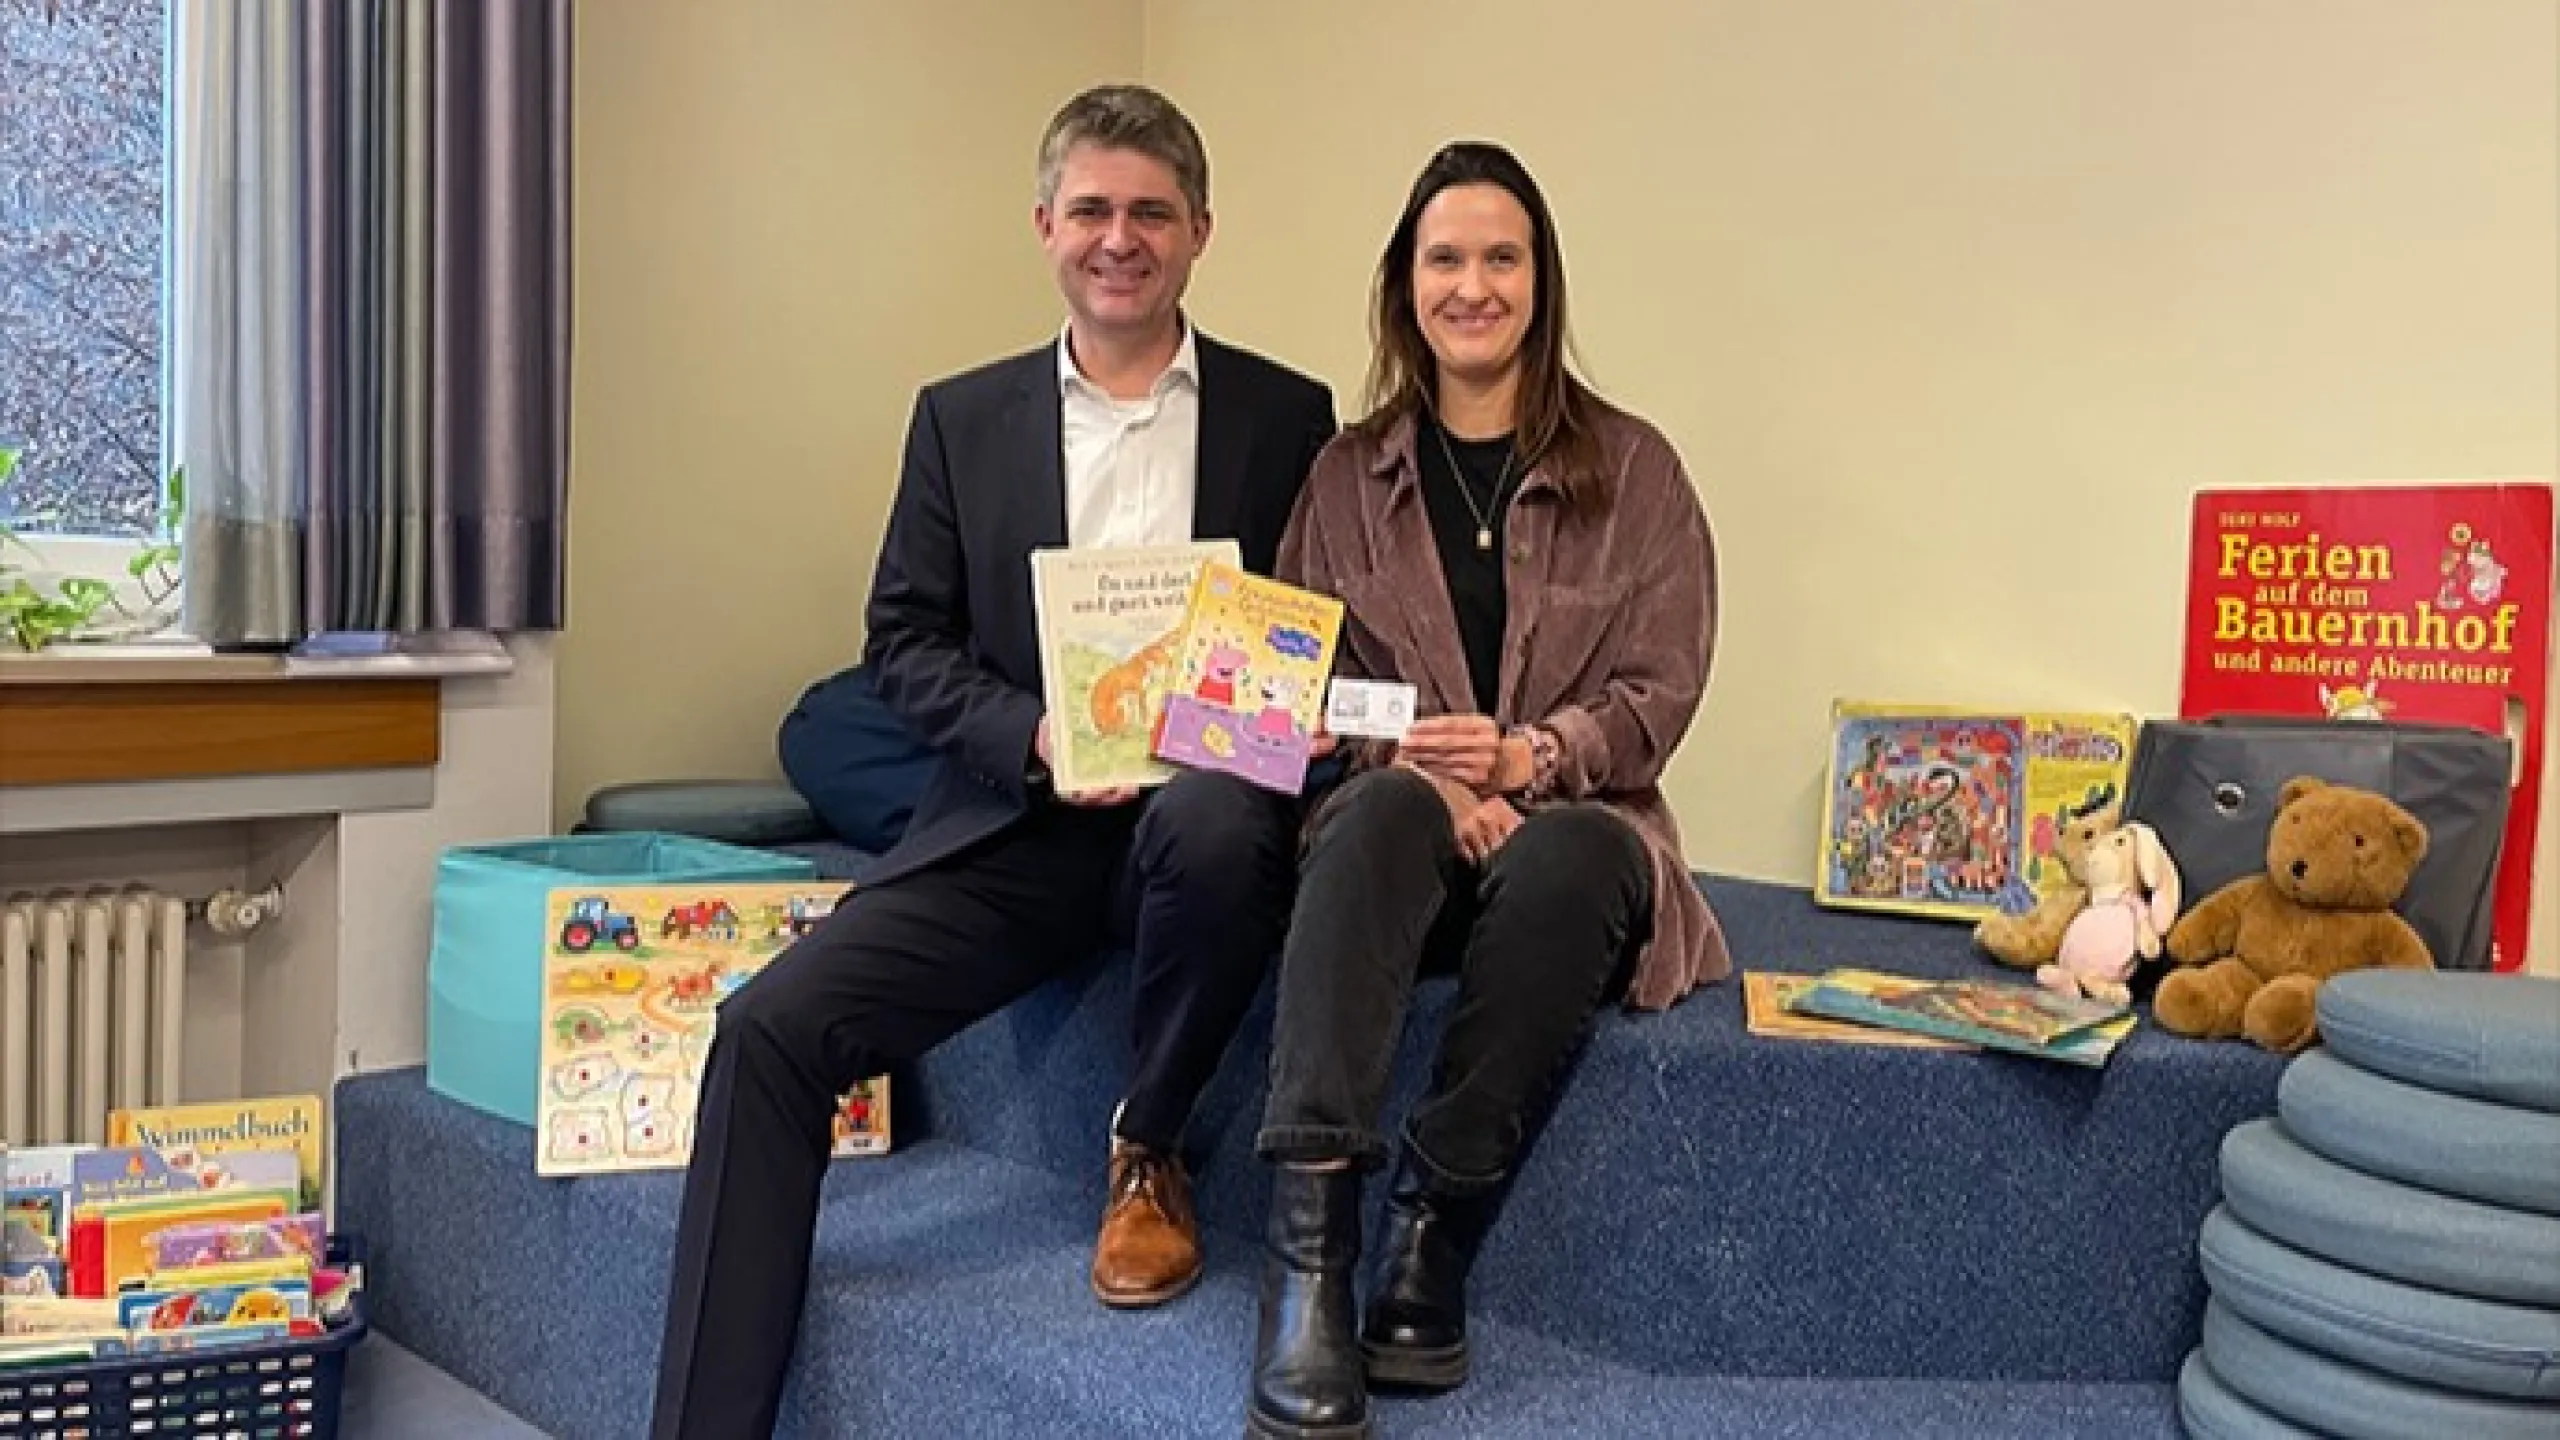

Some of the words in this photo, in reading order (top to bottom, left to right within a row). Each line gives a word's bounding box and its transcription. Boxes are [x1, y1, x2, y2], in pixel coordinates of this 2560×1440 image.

[2217, 532, 2393, 580] Ferien
[2255, 582, 2298, 606] auf
[2307, 581, 2368, 607] dem
[2214, 596, 2520, 653] Bauernhof
[2212, 649, 2261, 674] und
[2270, 651, 2358, 677] andere
[2368, 655, 2514, 685] Abenteuer
[136, 1106, 309, 1148] Wimmelbuch
